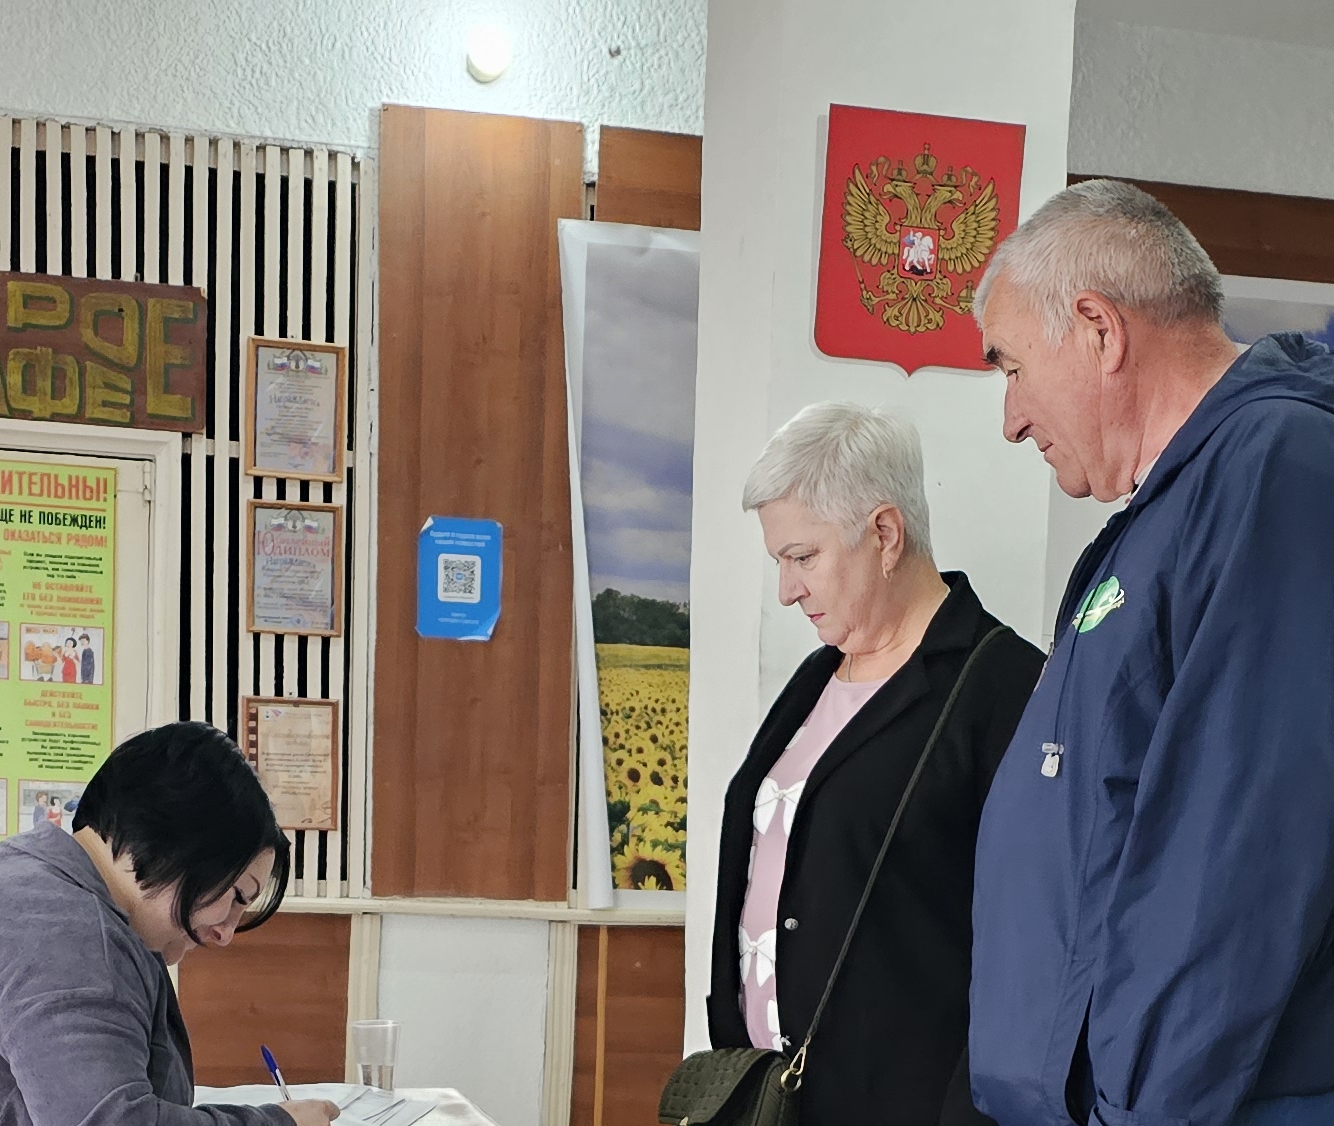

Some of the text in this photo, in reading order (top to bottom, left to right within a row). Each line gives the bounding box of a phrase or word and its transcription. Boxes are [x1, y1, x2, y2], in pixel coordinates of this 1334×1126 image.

[19, 510, 34, 525] НЕ
[38, 511, 106, 530] ПОБЕЖДЕН!
[3, 529, 63, 545] ОКАЗАТЬСЯ
[66, 533, 108, 549] РЯДОМ!
